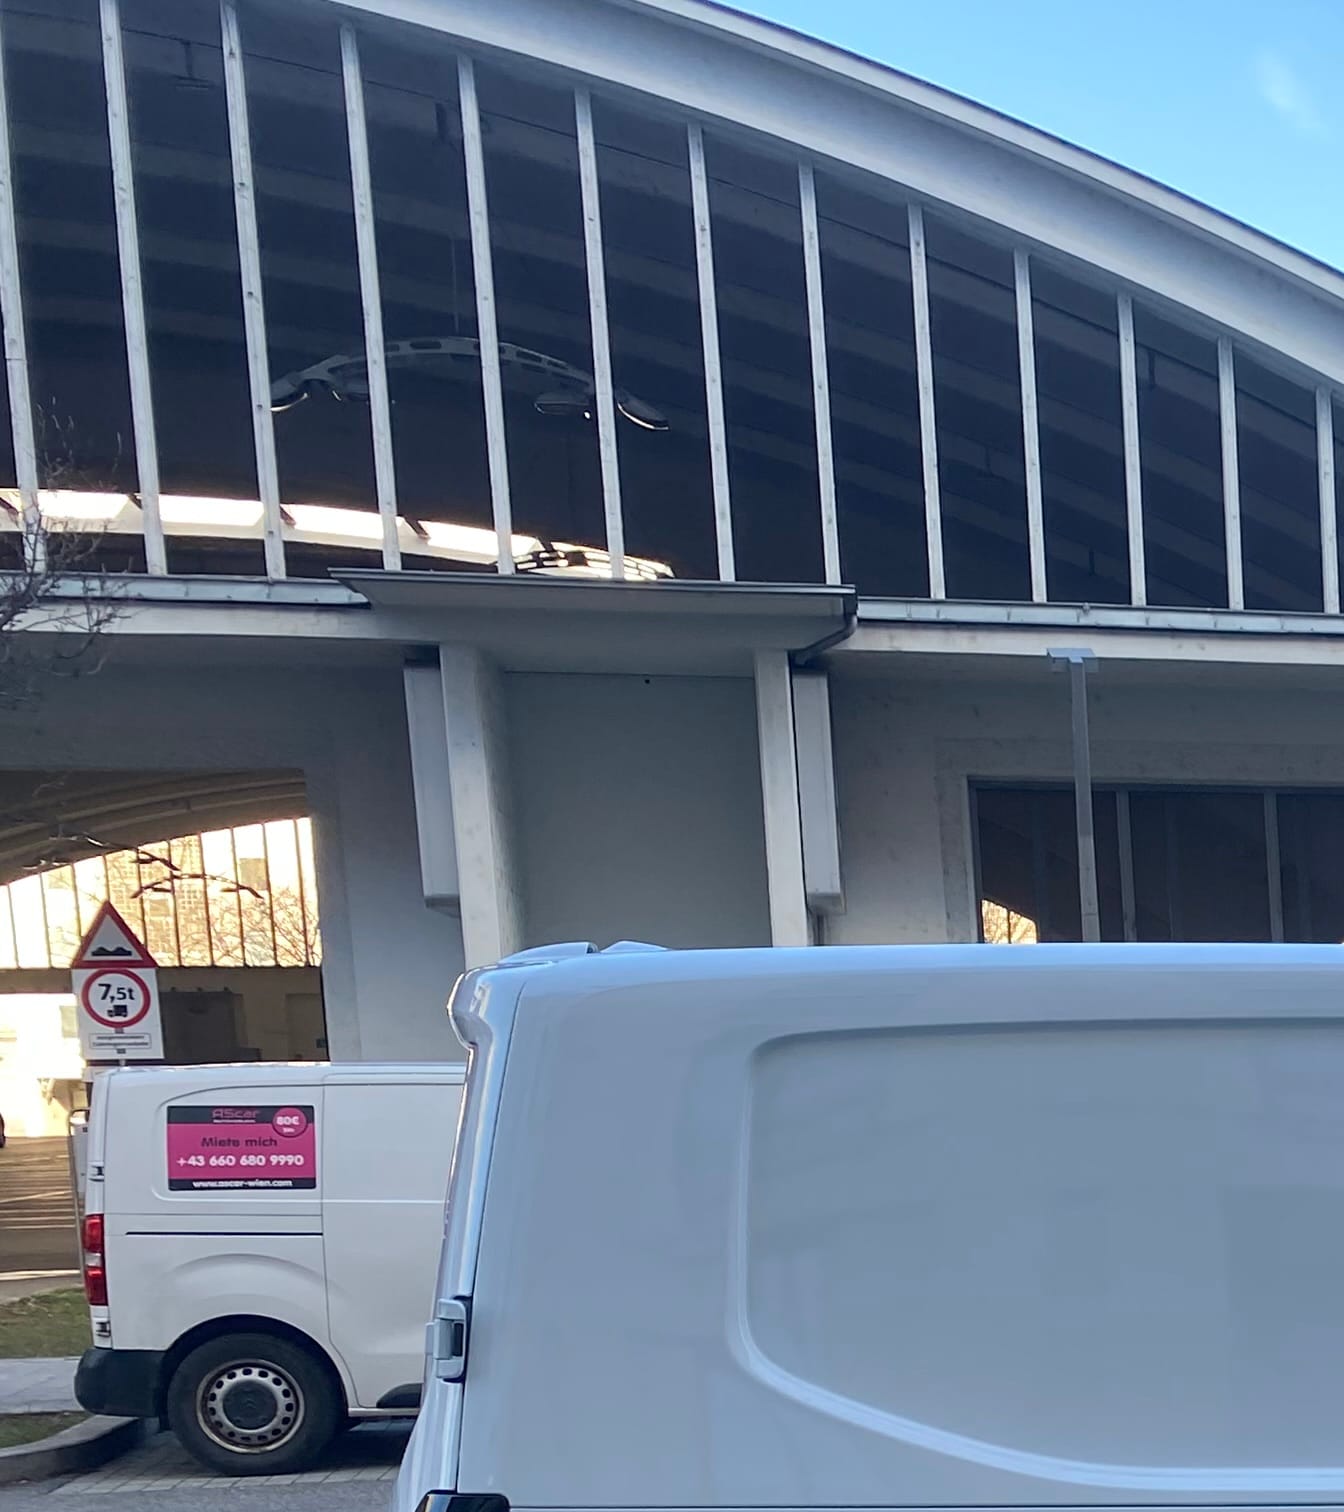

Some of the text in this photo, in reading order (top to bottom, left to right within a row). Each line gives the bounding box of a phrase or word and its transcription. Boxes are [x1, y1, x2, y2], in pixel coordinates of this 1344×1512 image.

[97, 983, 135, 1004] 7,5t
[245, 1137, 278, 1147] mich
[176, 1154, 304, 1167] +43 660 680 9990
